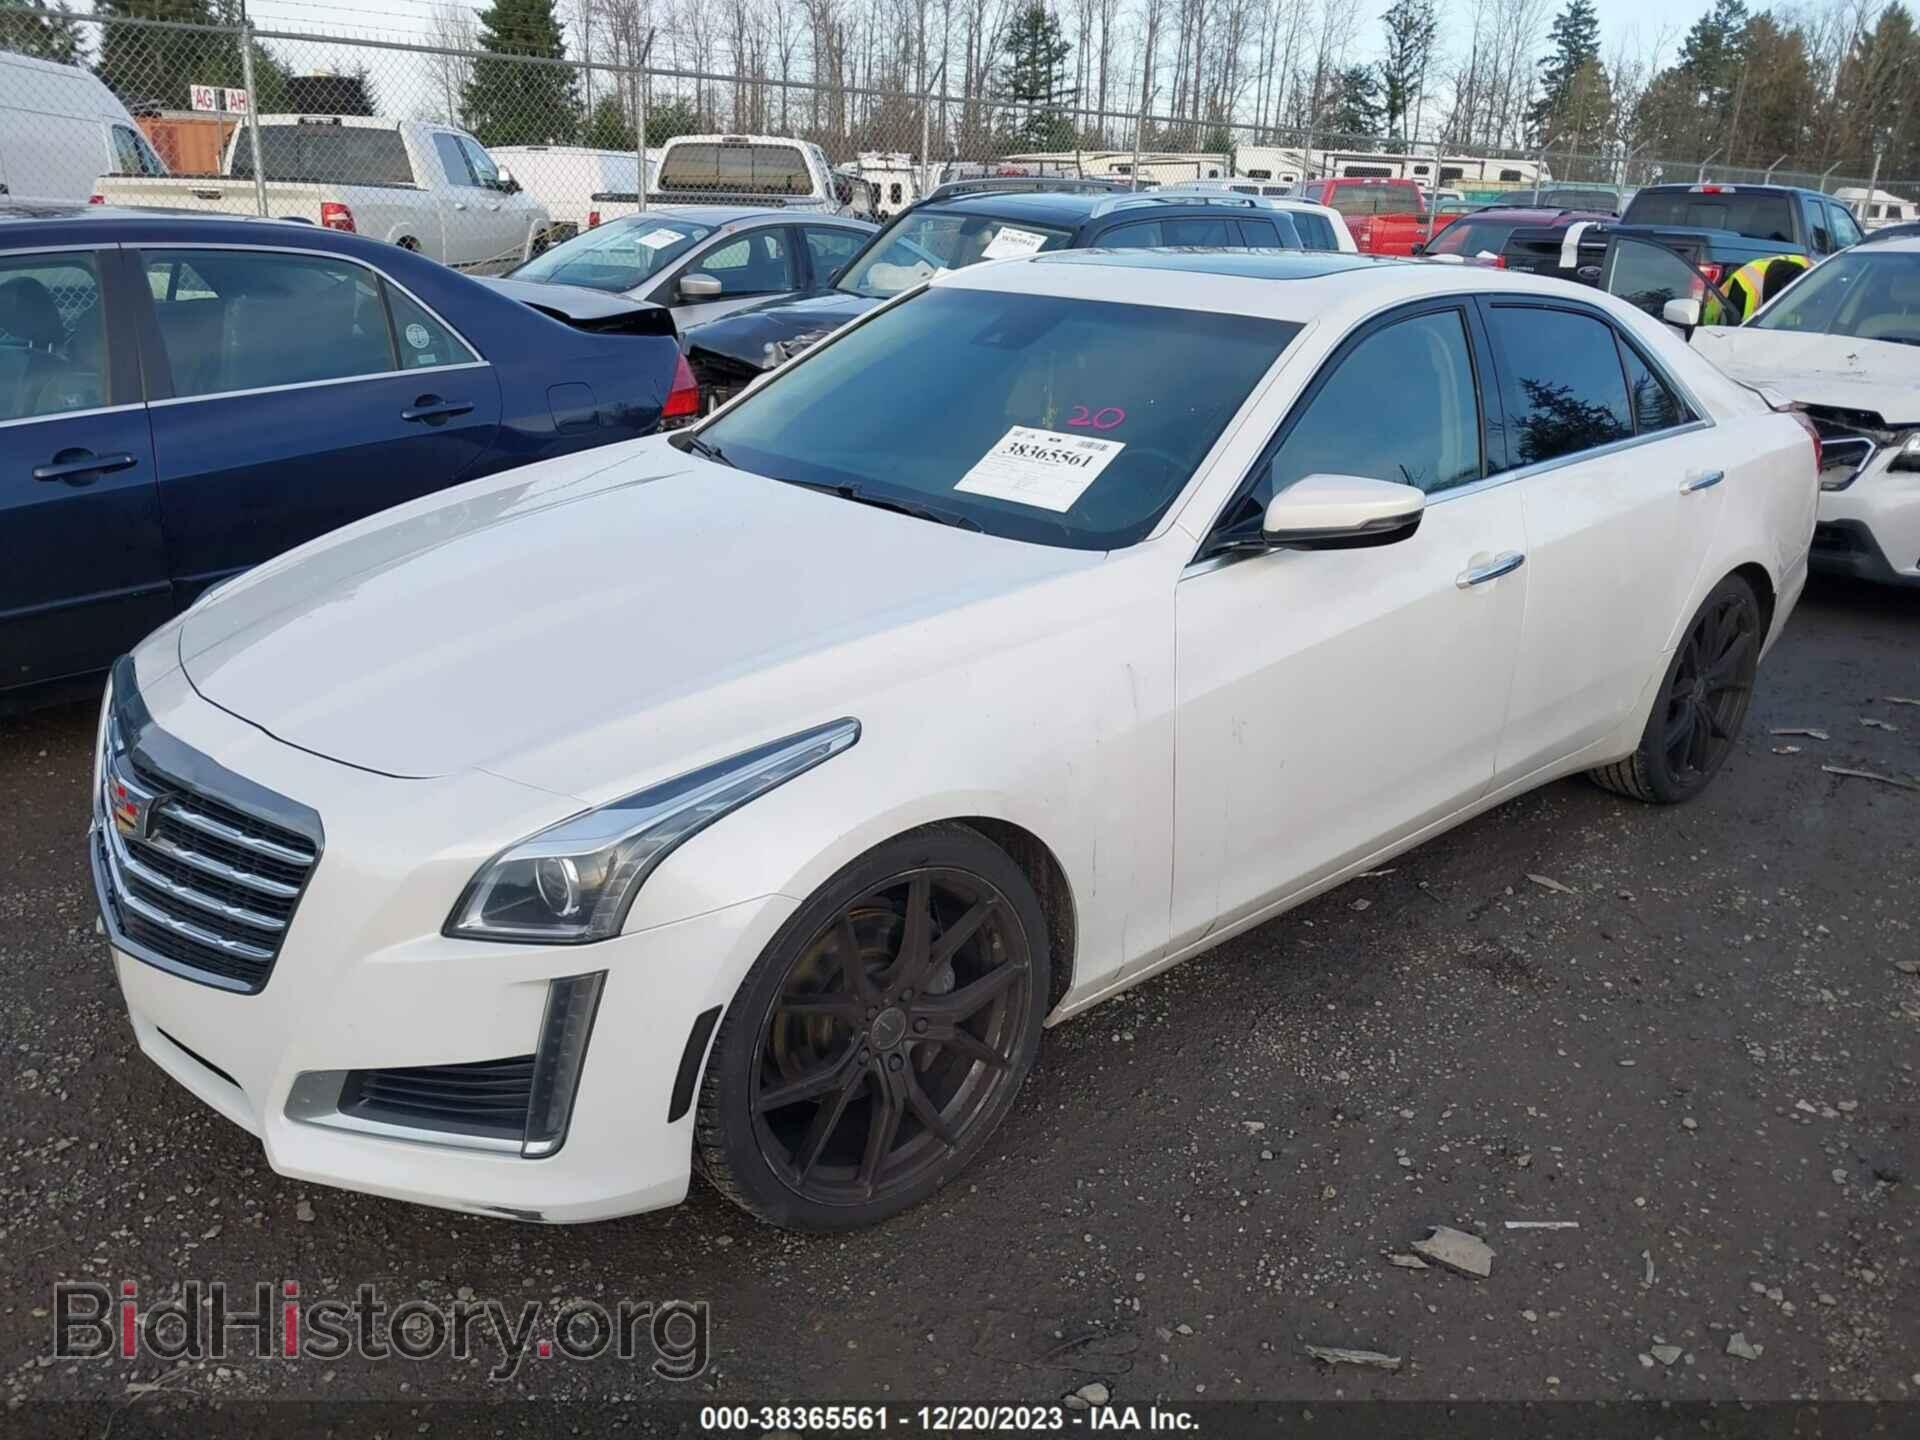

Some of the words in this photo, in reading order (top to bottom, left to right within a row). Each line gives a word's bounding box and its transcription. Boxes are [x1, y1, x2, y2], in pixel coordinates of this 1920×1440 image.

[196, 88, 213, 108] AG
[230, 91, 247, 113] AH
[1067, 406, 1126, 429] 20
[1002, 442, 1094, 468] 38365561
